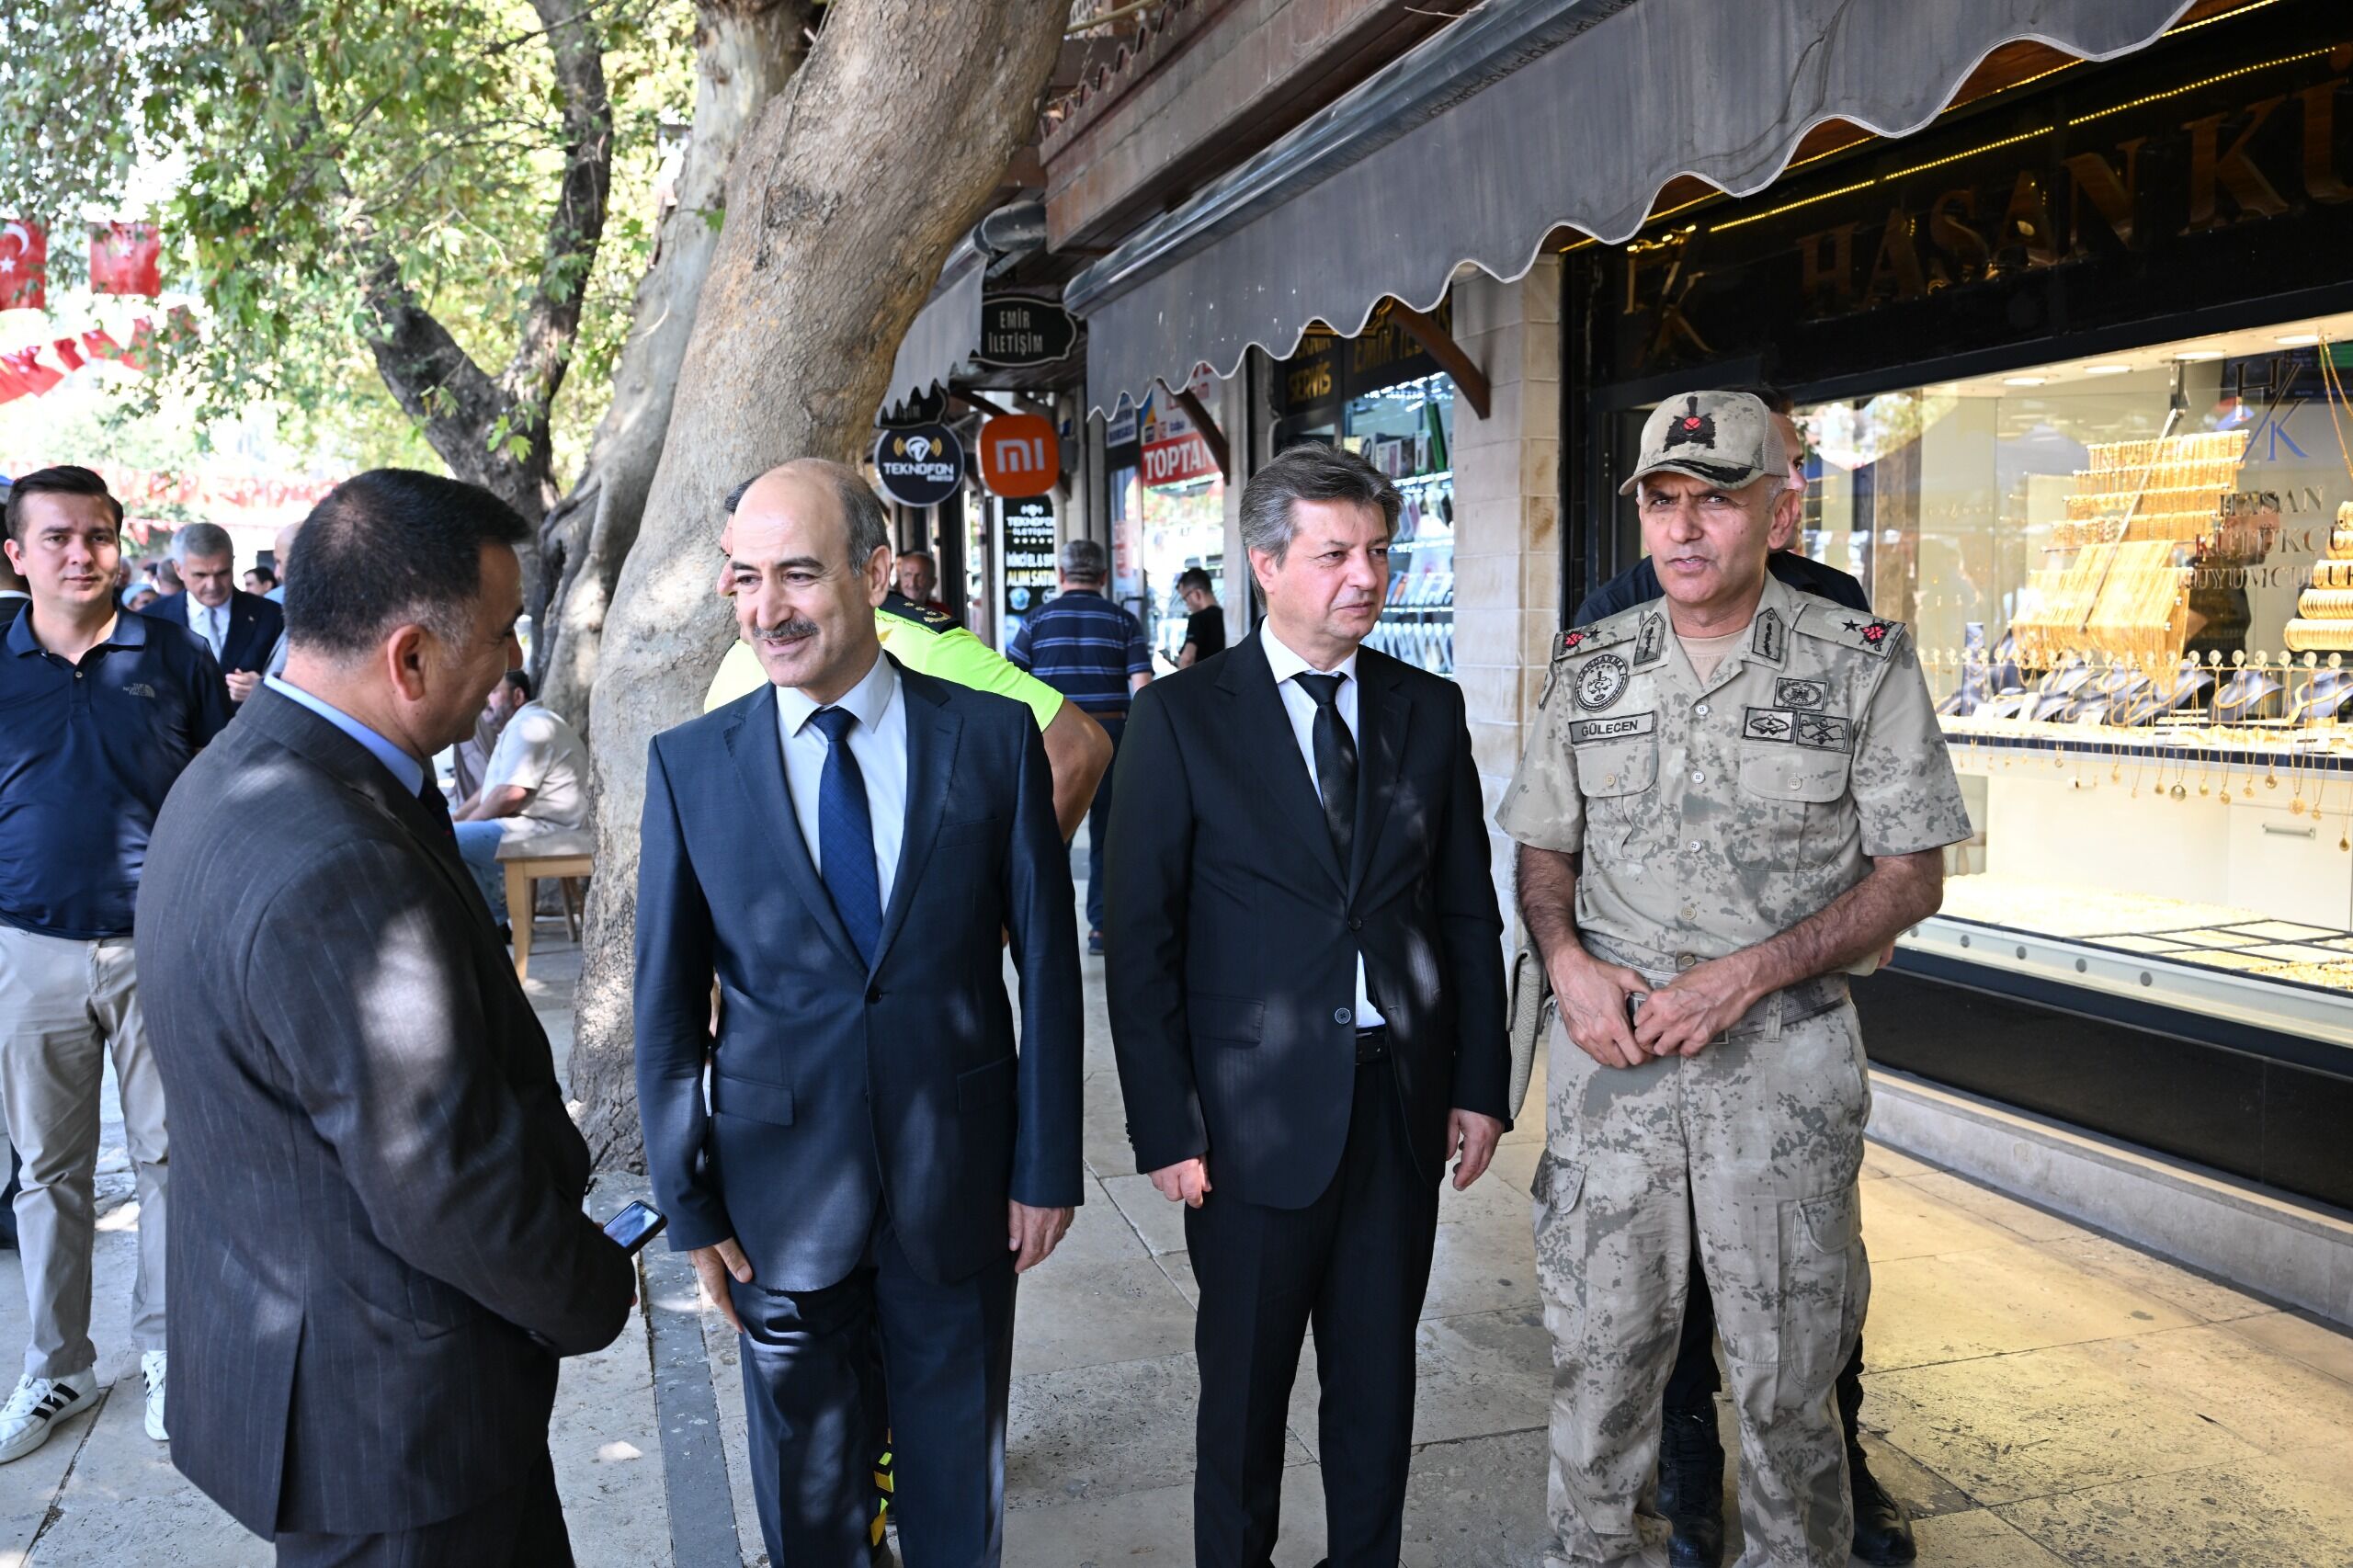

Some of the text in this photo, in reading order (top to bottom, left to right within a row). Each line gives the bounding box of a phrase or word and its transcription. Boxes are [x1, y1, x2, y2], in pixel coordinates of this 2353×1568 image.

[1797, 135, 2148, 324] HASAN
[1000, 307, 1030, 329] EMİR
[988, 332, 1043, 356] İLETİŞİM
[882, 462, 955, 475] TEKNOFON
[2220, 486, 2324, 516] HASAN
[1578, 654, 1625, 683] JANDARMA
[1581, 720, 1639, 736] GÜLECEN
